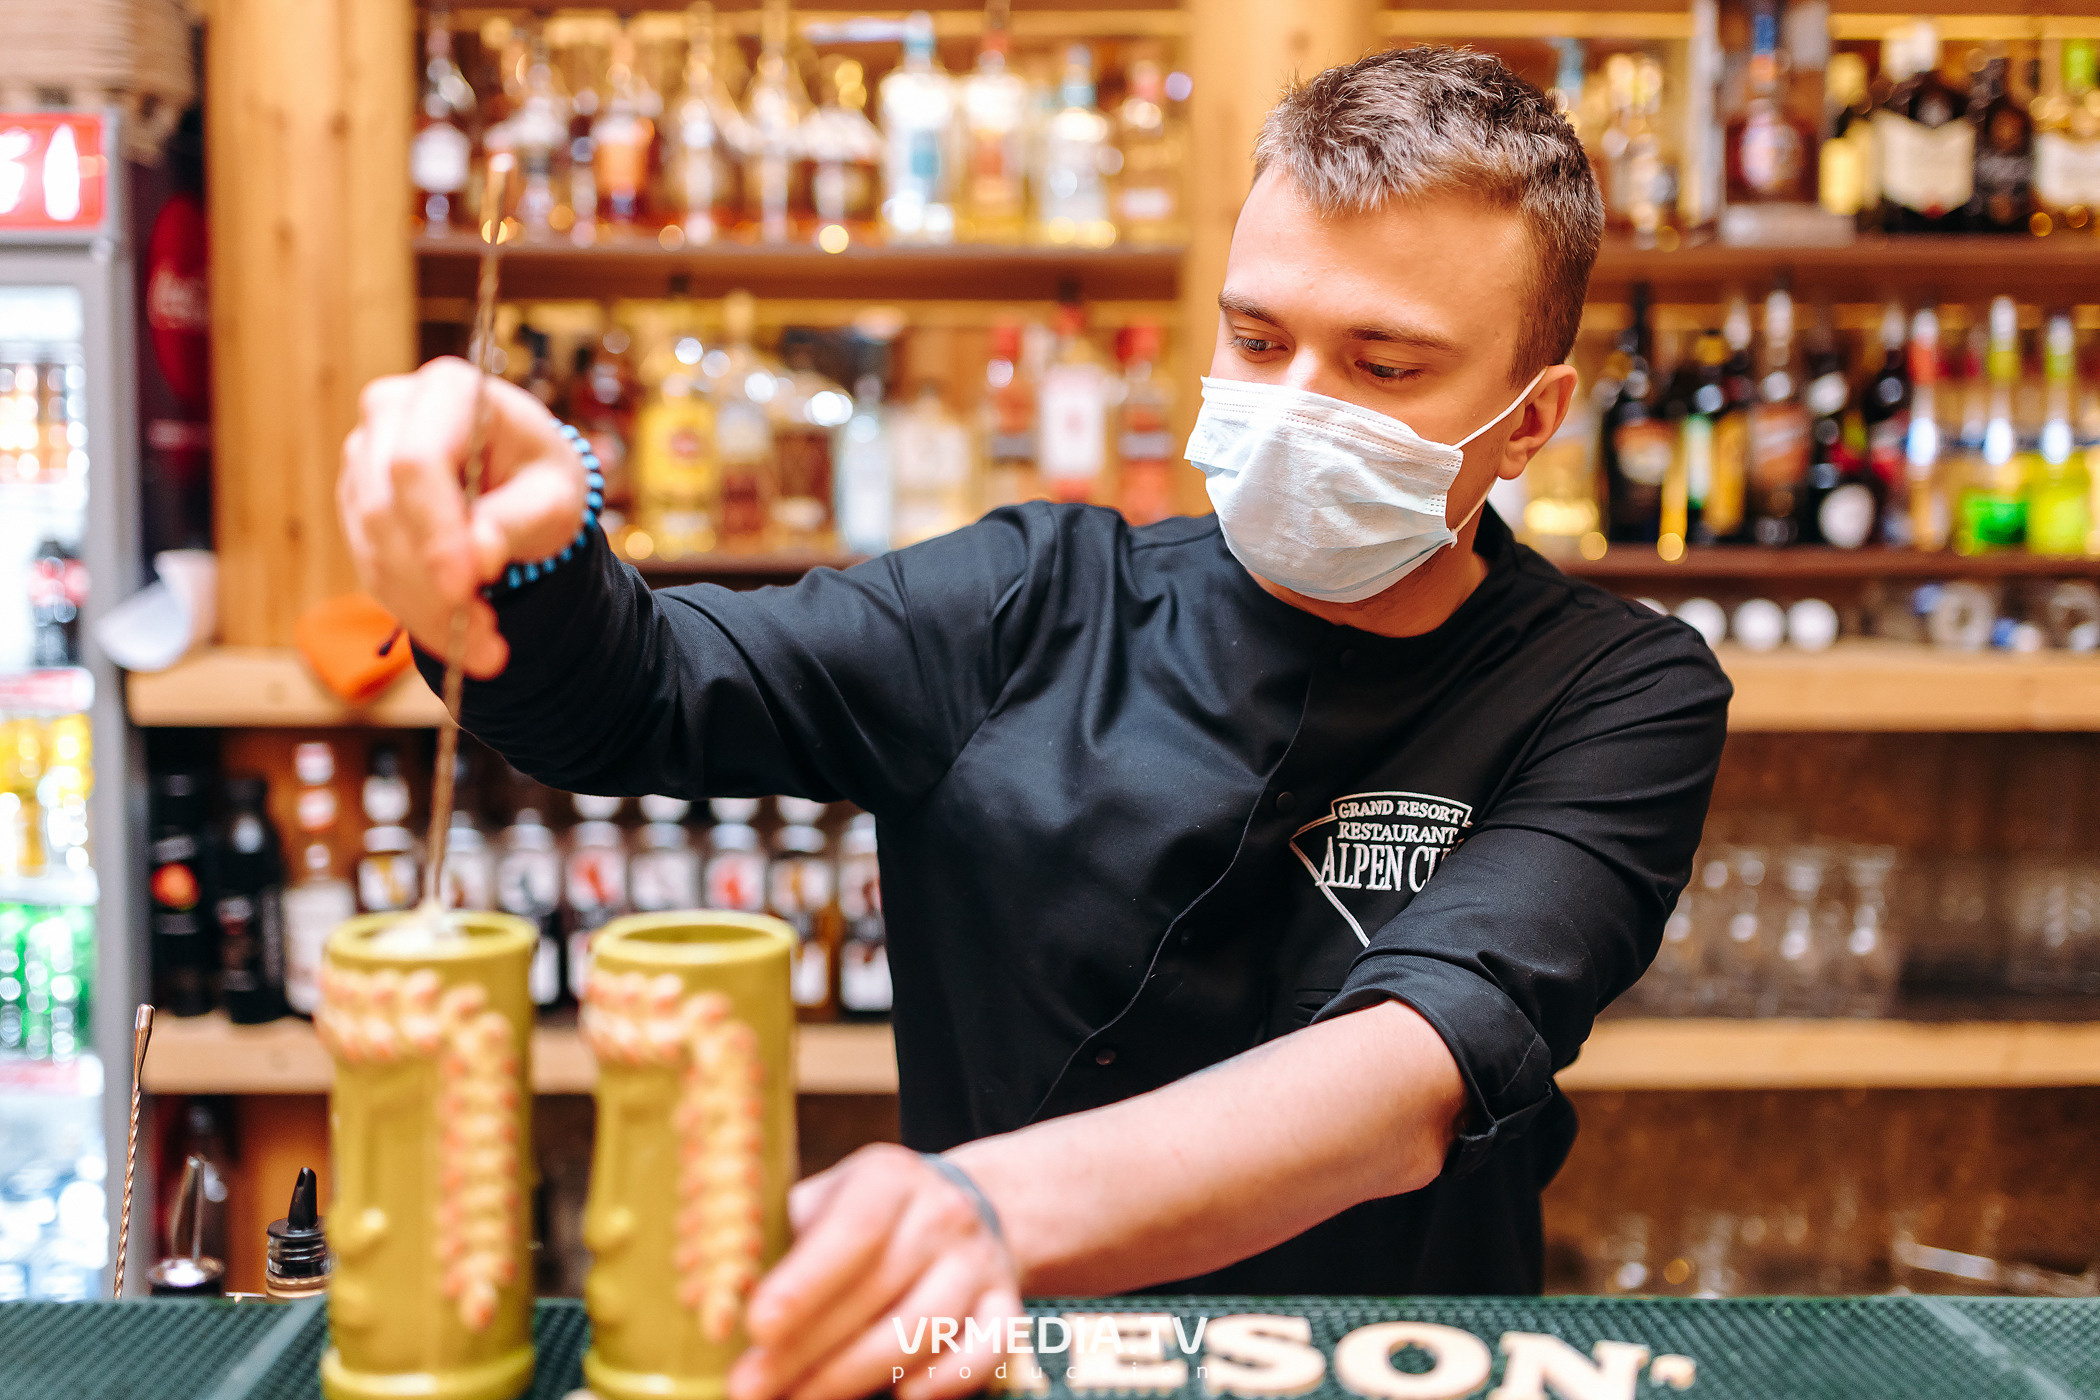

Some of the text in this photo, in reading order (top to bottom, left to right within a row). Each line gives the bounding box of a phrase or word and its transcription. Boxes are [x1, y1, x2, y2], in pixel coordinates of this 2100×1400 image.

[1338, 800, 1464, 824] GRAND RESORT
[1336, 821, 1459, 845] RESTAURANT
[1315, 836, 1406, 891] ALPEN
[1010, 1312, 1650, 1400] ESON
